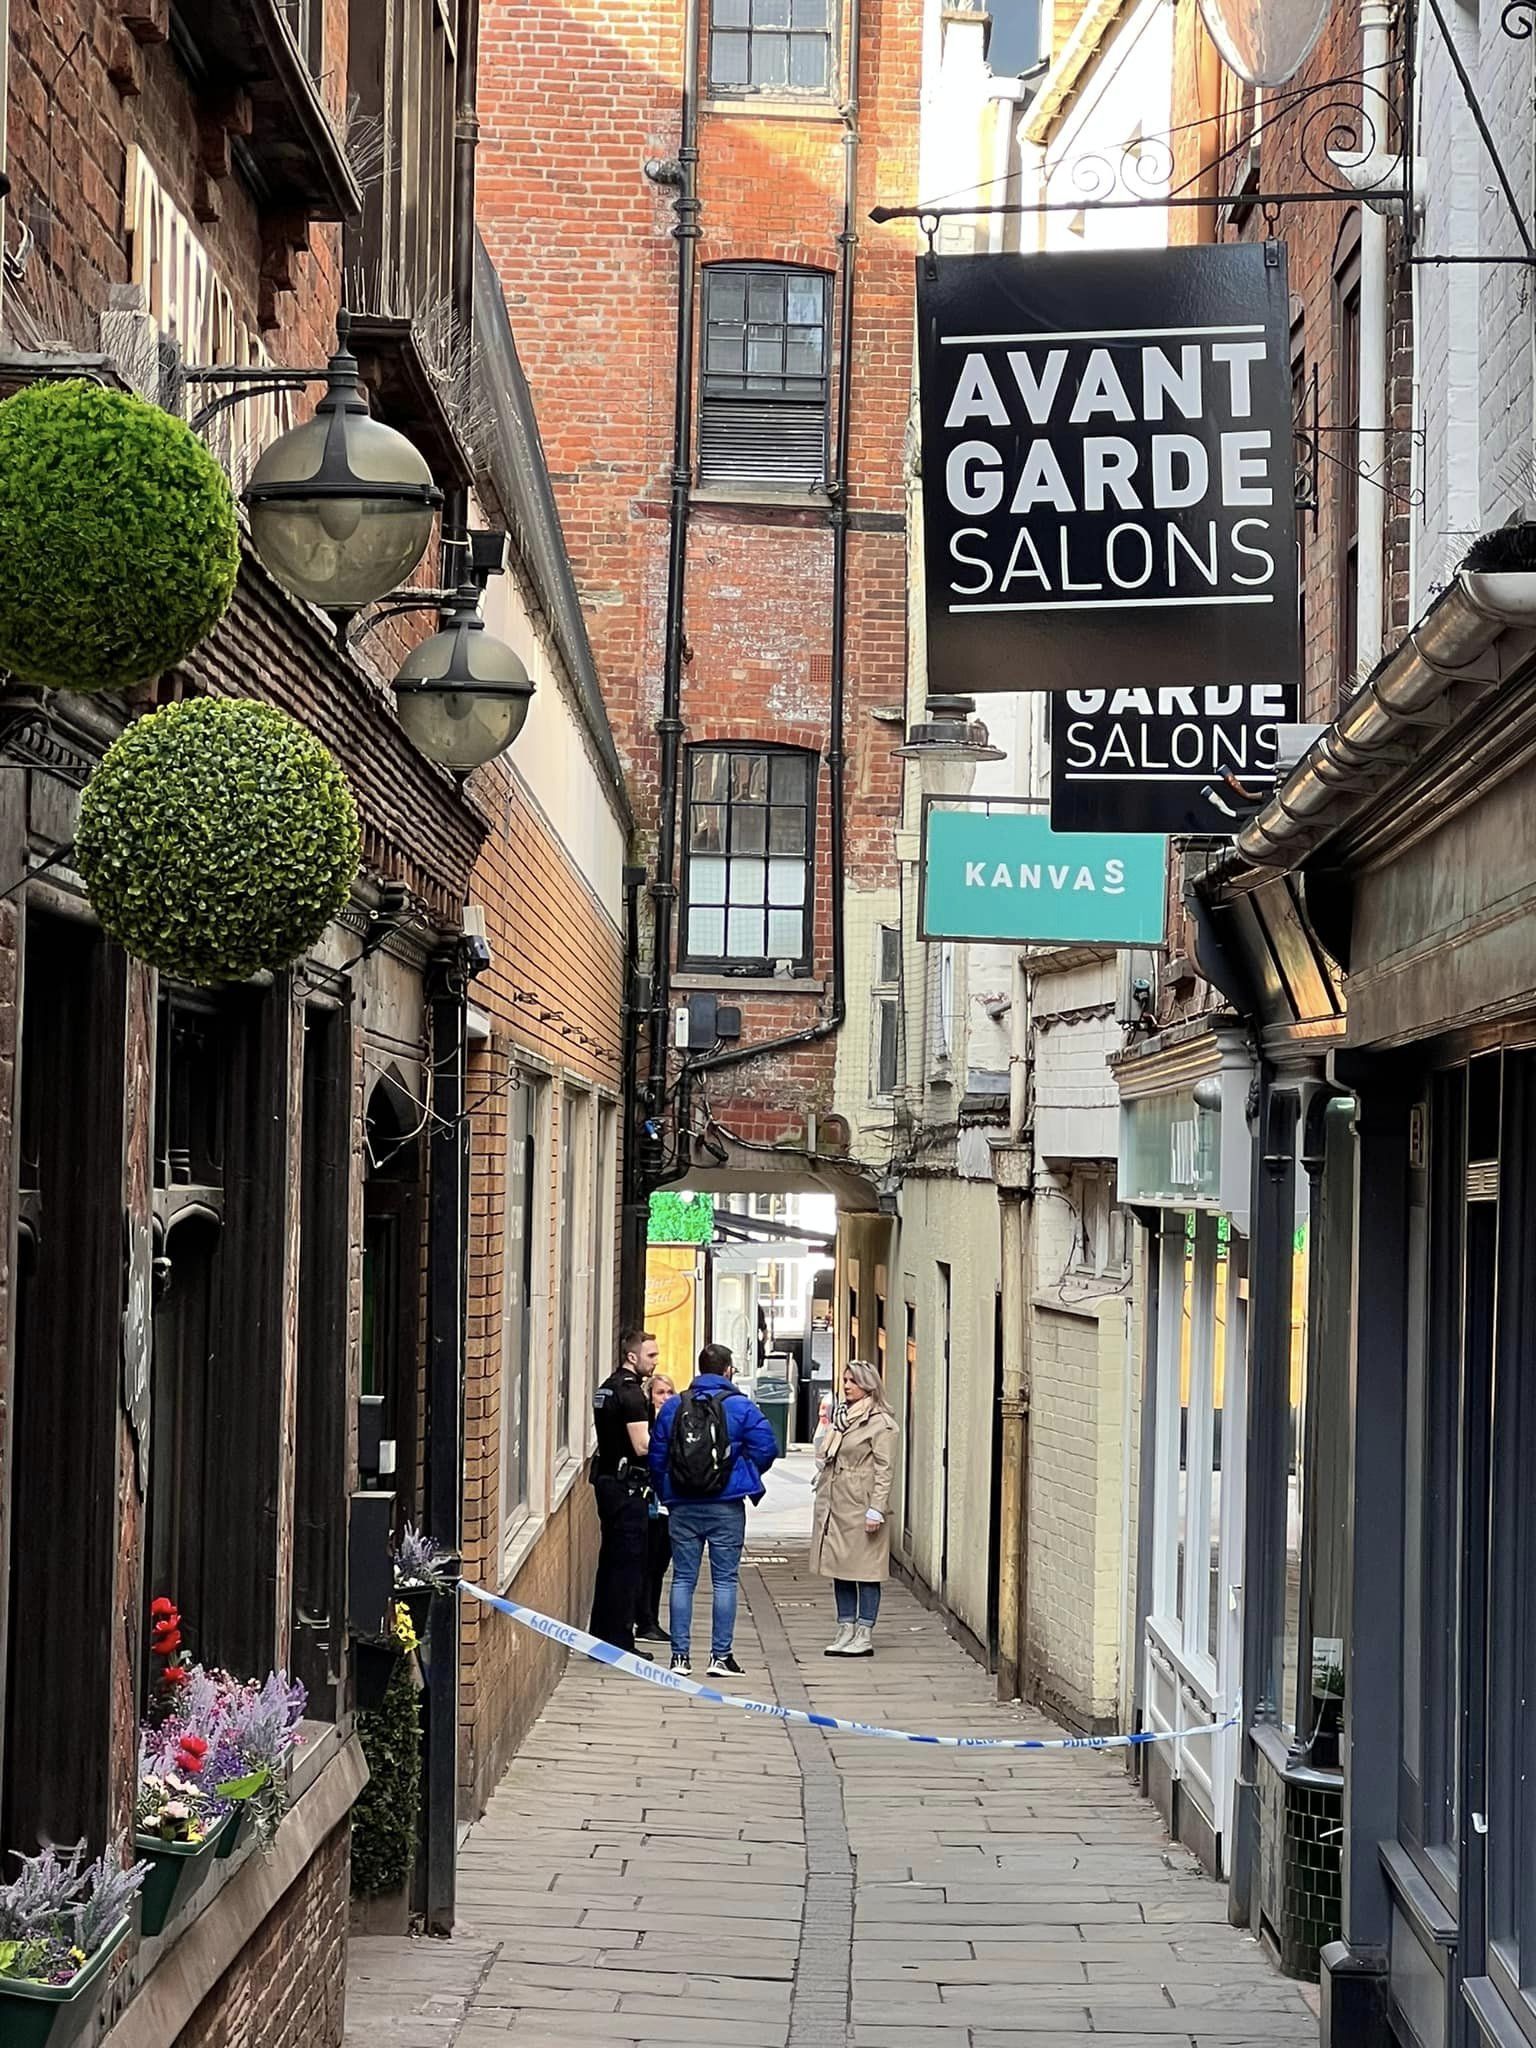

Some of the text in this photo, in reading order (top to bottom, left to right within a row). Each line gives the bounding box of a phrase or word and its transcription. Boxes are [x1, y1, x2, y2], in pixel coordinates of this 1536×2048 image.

[944, 342, 1267, 428] AVANT
[945, 430, 1273, 516] GARDE
[949, 518, 1275, 595] SALONS
[1066, 721, 1278, 770] SALONS
[965, 859, 1125, 891] KANVAS
